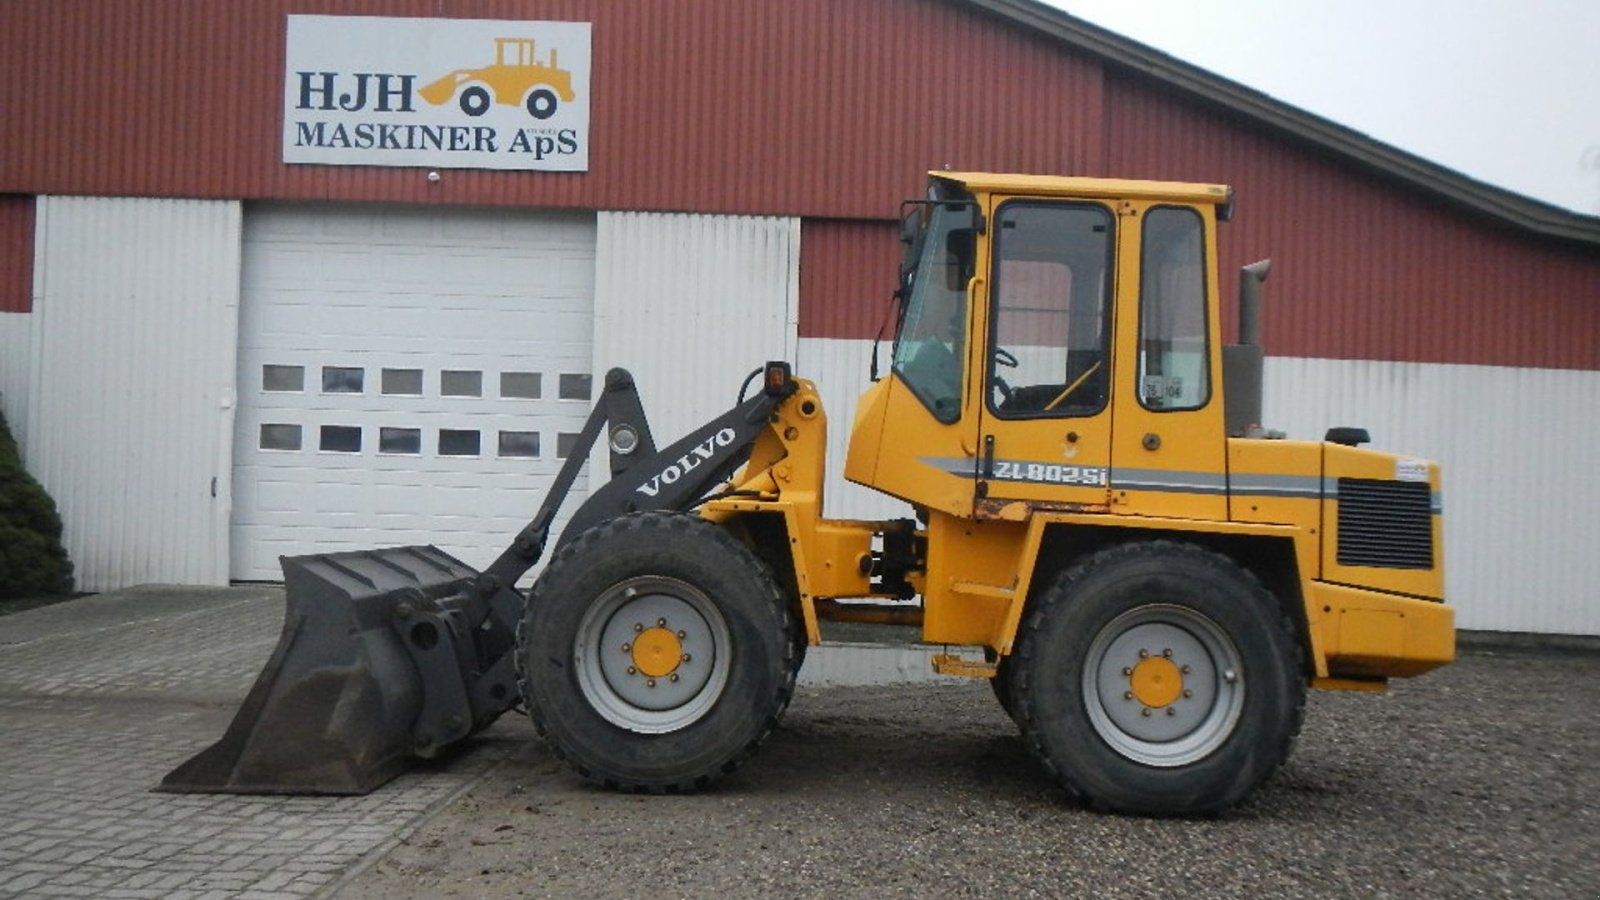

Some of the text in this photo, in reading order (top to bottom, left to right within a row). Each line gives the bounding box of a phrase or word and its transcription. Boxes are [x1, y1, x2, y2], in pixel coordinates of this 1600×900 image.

[295, 71, 417, 112] HJH
[294, 121, 578, 160] MASKINER ApS
[635, 427, 736, 497] VOLVO
